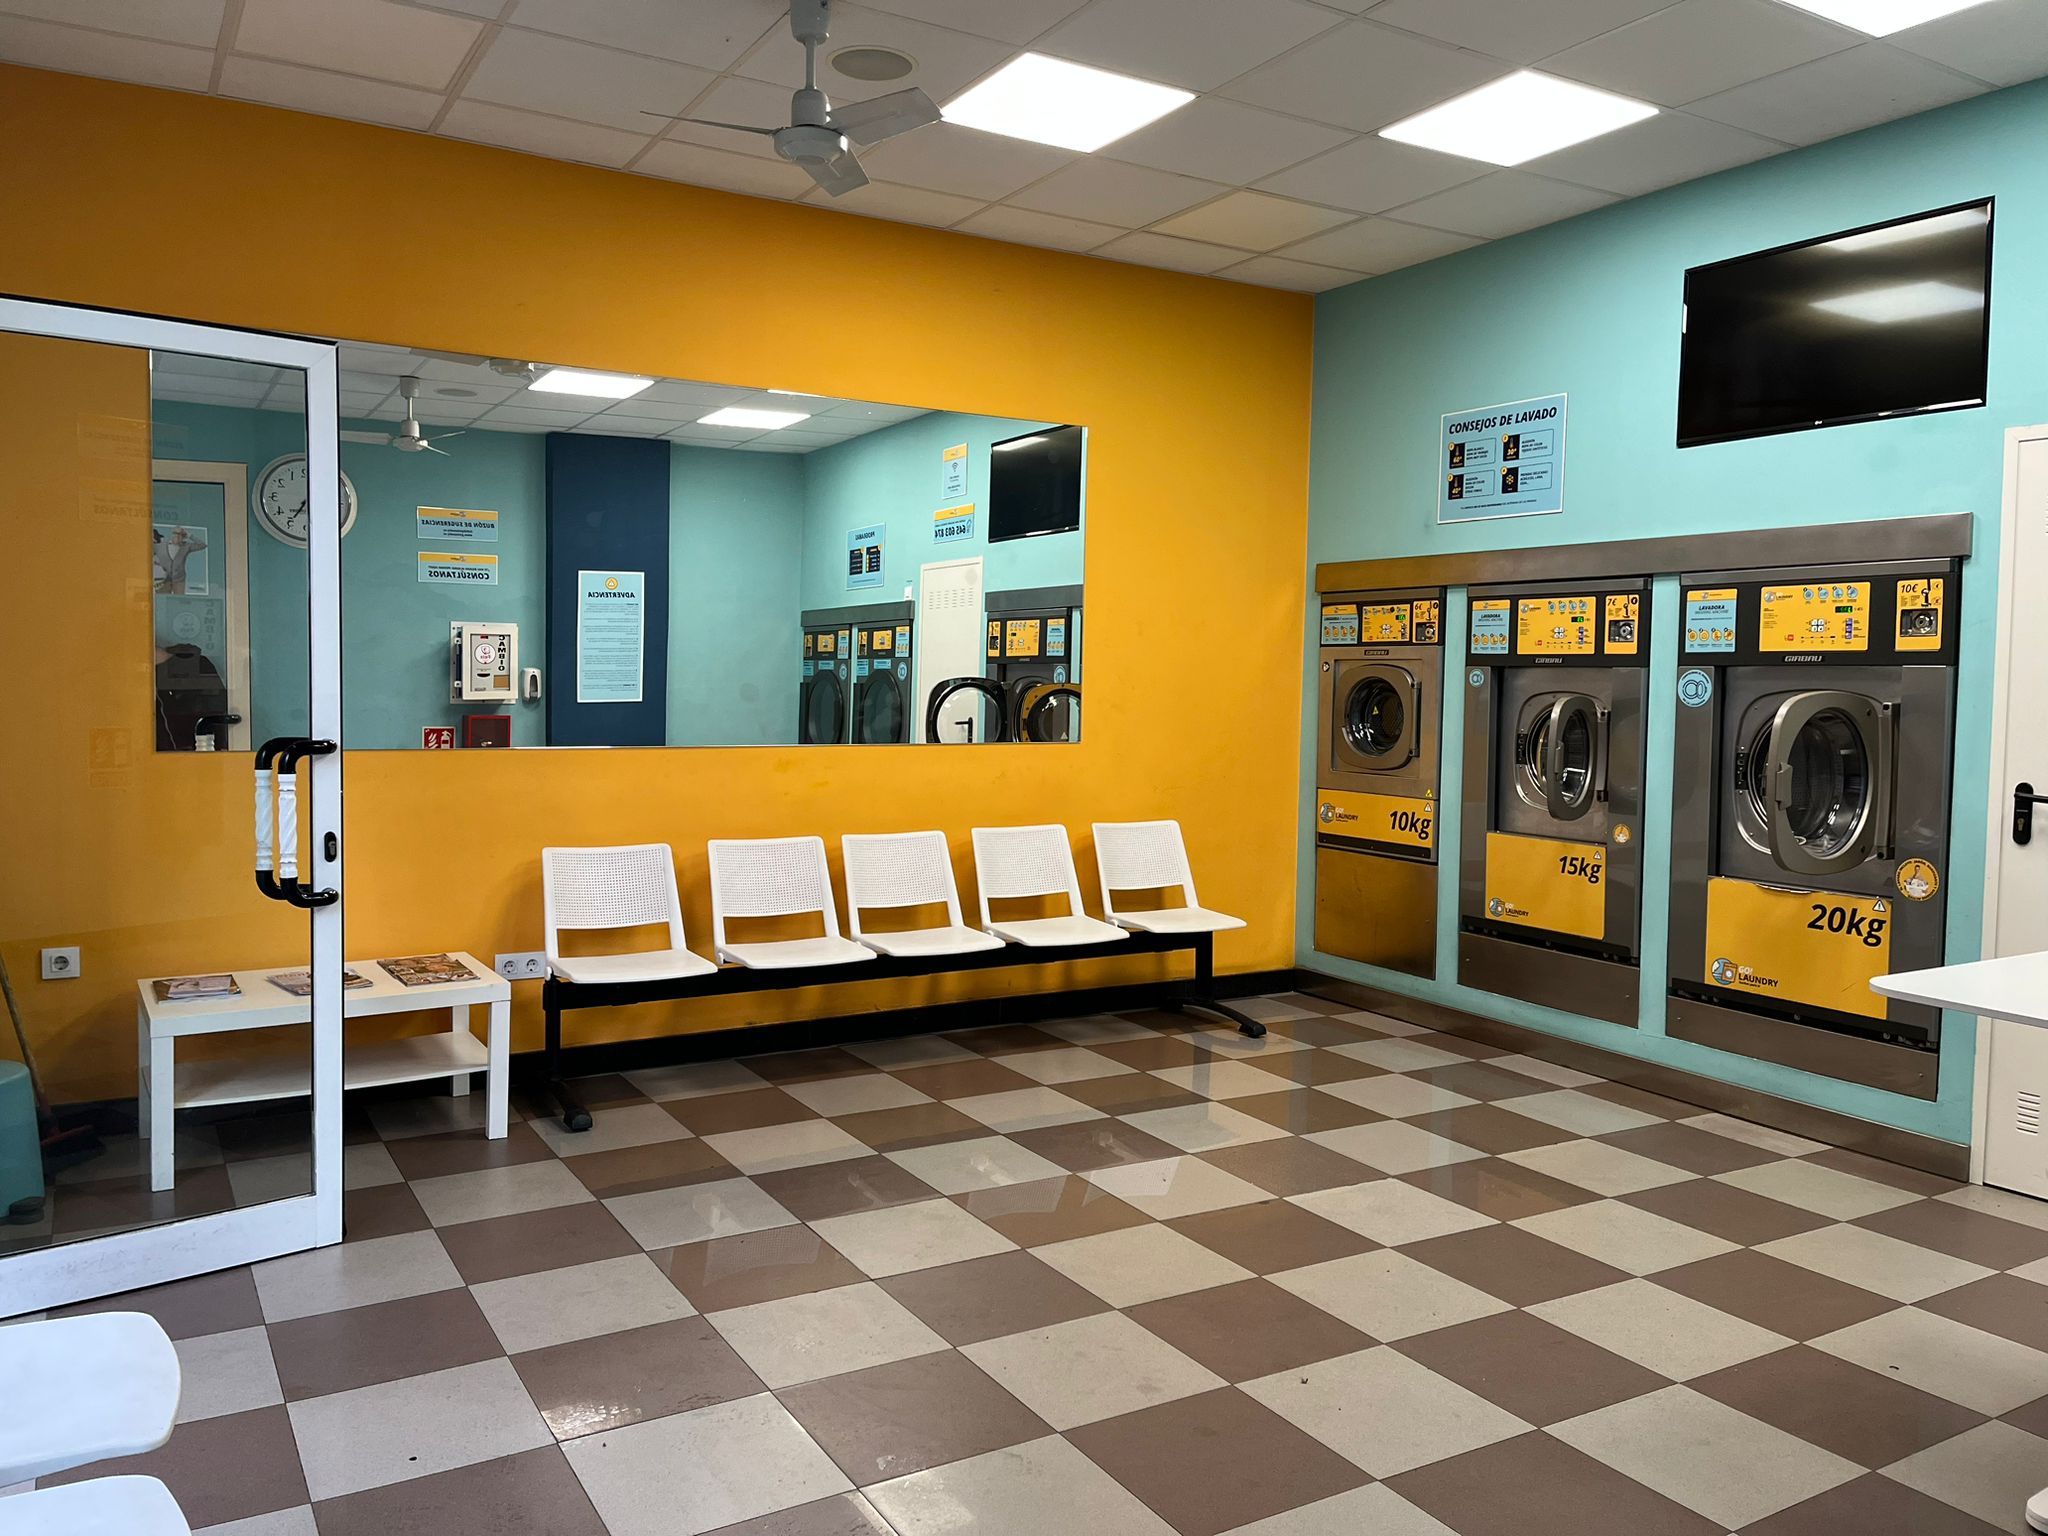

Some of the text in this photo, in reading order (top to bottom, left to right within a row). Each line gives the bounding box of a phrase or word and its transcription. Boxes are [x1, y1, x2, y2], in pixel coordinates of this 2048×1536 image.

[1449, 406, 1558, 435] CONSEJOS DE LAVADO
[1901, 583, 1918, 593] 10€
[1335, 812, 1359, 821] LAUNDRY
[1390, 810, 1432, 840] 10kg
[1559, 855, 1602, 884] 15kg
[1505, 907, 1529, 917] LAUNDRY
[1807, 903, 1887, 947] 20kg
[1738, 965, 1754, 975] GO!
[1738, 973, 1779, 988] LAUNDRY
